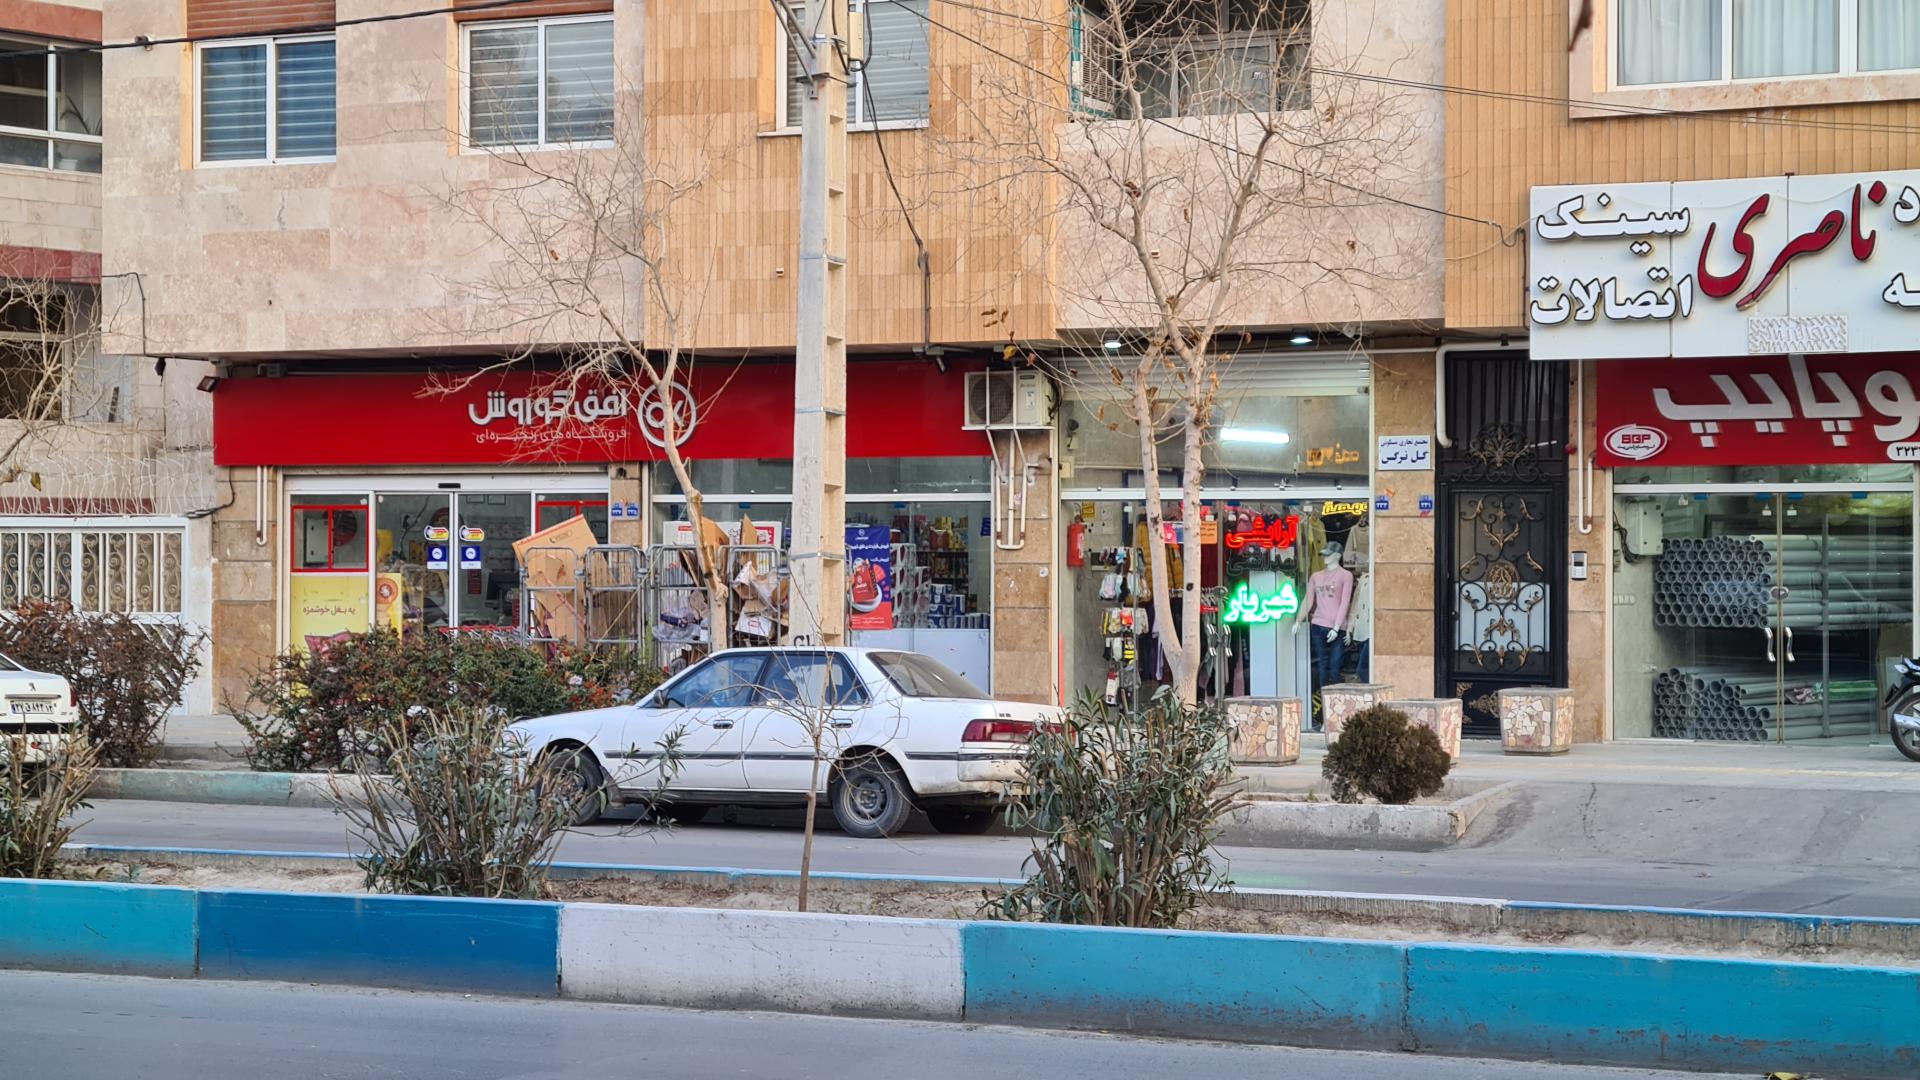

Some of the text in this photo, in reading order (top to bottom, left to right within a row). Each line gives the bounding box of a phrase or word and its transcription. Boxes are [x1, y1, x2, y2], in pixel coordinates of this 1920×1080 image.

[1536, 192, 1690, 256] سینک
[1697, 180, 1887, 310] ناصری
[1531, 266, 1693, 325] اتصالات
[574, 388, 627, 423] افق
[1226, 514, 1299, 549] آرایشی
[303, 605, 330, 615] خوشمزه
[1224, 582, 1298, 623] شهریار
